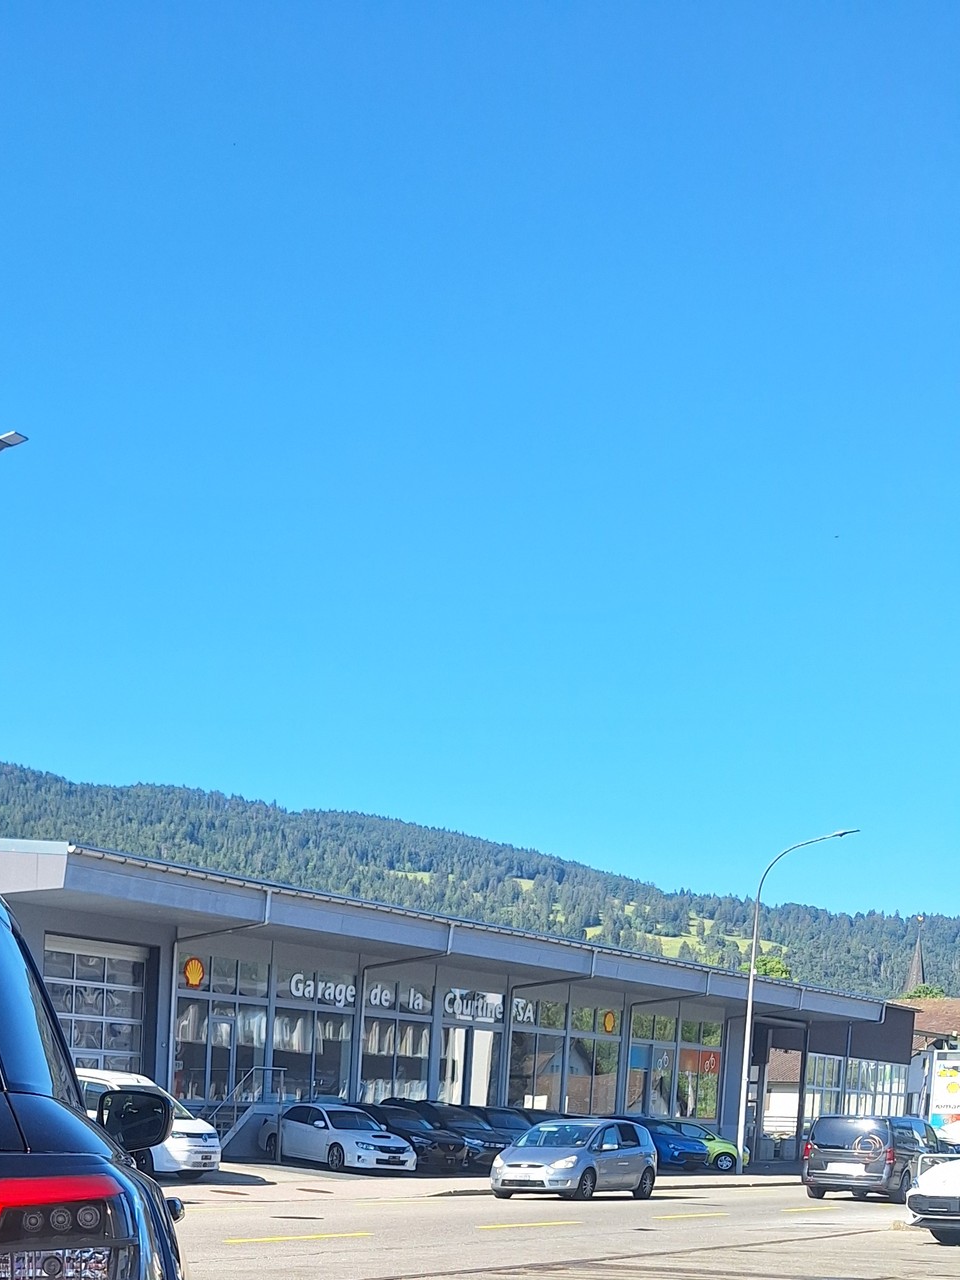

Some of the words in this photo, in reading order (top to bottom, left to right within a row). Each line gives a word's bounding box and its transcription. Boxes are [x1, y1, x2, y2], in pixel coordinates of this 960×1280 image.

[290, 974, 356, 1008] Garage
[370, 984, 390, 1007] de
[409, 988, 423, 1010] la
[443, 992, 504, 1020] Courtine
[516, 1001, 535, 1023] SA
